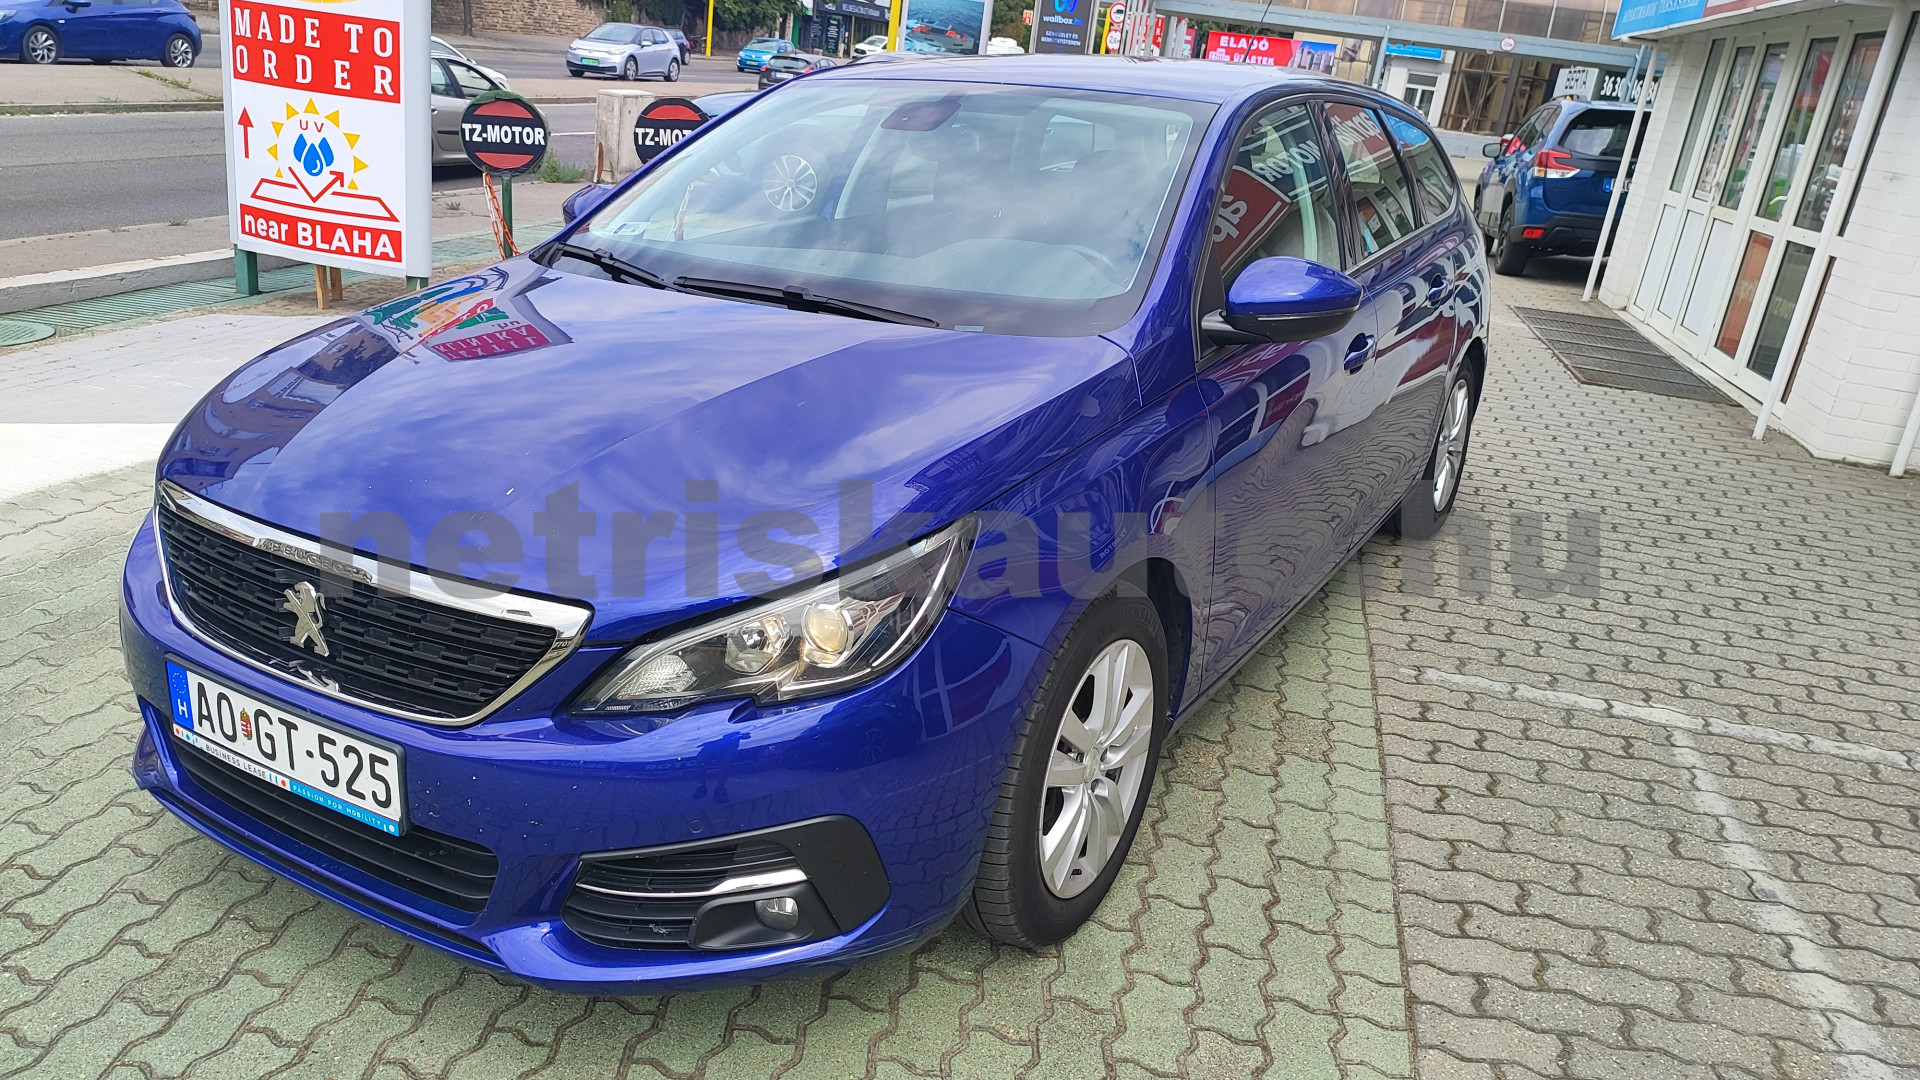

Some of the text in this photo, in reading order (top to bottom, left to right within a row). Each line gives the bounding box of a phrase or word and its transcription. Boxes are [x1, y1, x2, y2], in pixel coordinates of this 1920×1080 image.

[234, 7, 393, 58] MADE TO
[1220, 35, 1269, 51] ELADÓ
[235, 44, 395, 96] ORDER
[461, 122, 546, 146] TZ-MOTOR
[635, 127, 693, 146] TZ-MO
[244, 213, 397, 259] near BLAHA
[177, 698, 189, 719] H
[197, 681, 392, 809] AO GT-525
[205, 743, 267, 779] BUSINESS LEASE
[292, 784, 382, 827] PASSION FOR MOBILITY
